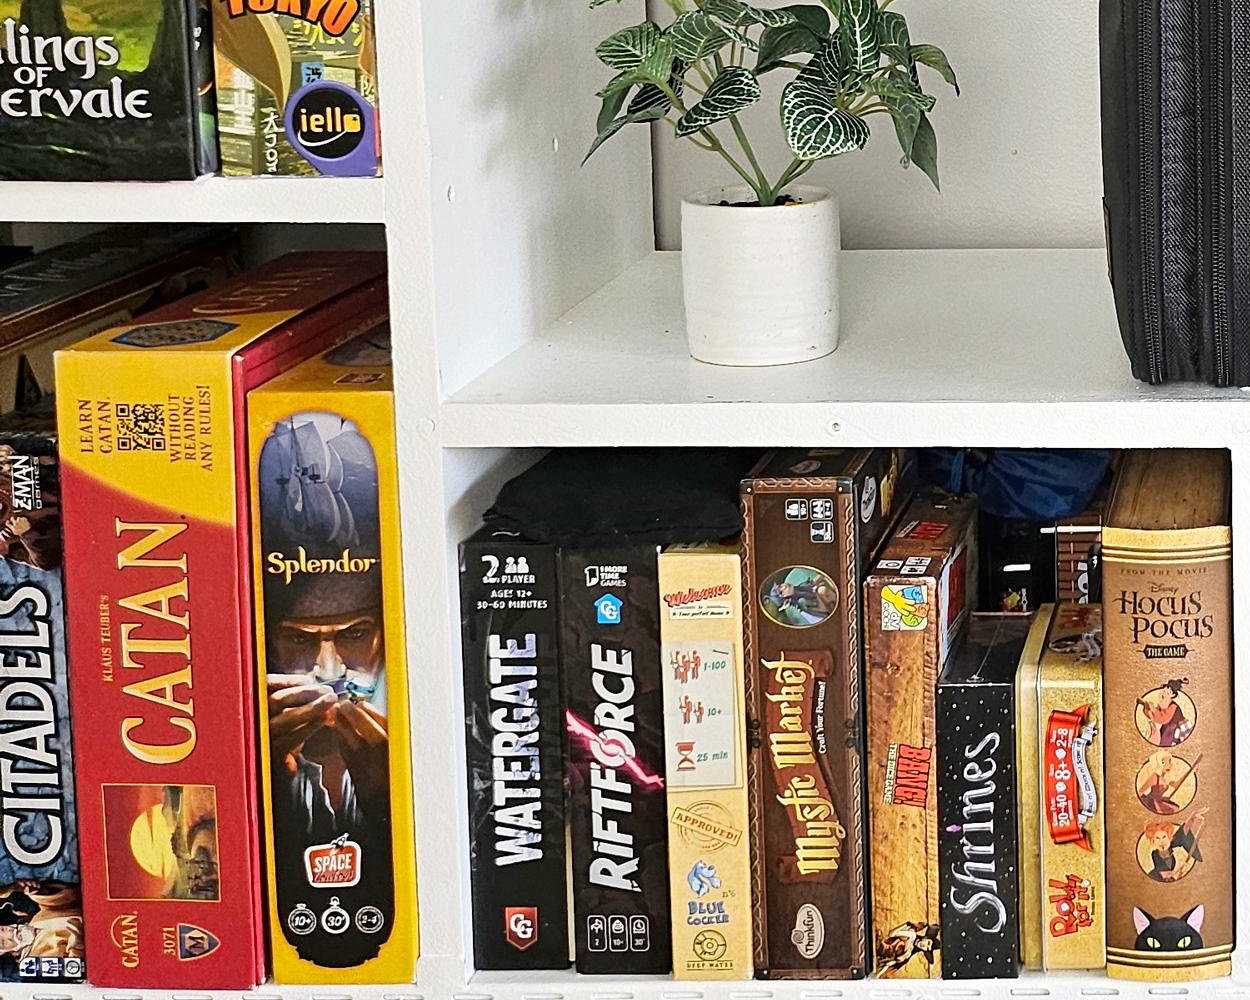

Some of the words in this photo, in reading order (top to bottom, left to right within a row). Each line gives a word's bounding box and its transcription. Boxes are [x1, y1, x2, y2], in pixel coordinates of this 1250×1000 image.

[0, 19, 118, 80] lings
[301, 107, 361, 133] iello
[196, 385, 212, 437] RULES!
[79, 399, 94, 453] LEARN
[169, 394, 182, 462] WITHOUT
[184, 396, 197, 460] READING
[201, 439, 213, 471] ANY
[267, 545, 376, 585] Splendor
[501, 575, 535, 584] PLAYER
[1177, 567, 1207, 575] MOVIE
[508, 600, 547, 609] MINUTES
[1112, 590, 1202, 617] HOCUS
[101, 595, 112, 643] TEUBER'S
[1129, 615, 1214, 644] POCUS
[116, 516, 197, 764] CATAN
[1147, 647, 1162, 656] THE
[1164, 647, 1185, 657] GAME
[102, 646, 113, 682] KLAUS
[761, 650, 816, 769] Market
[815, 681, 827, 712] Fortune!
[0, 583, 63, 865] CITADELS
[707, 707, 722, 716] 10+
[815, 714, 826, 732] Your
[490, 633, 543, 866] WATERGATE
[818, 733, 827, 754] Craft
[1055, 728, 1069, 747] 2-8
[697, 752, 710, 762] 25
[712, 751, 728, 760] min
[1055, 761, 1071, 780] 8+
[894, 744, 932, 808] BANG!
[776, 774, 846, 875] Mystic
[1056, 794, 1070, 827] 20-40
[676, 813, 738, 842] APPROVED!
[950, 731, 1007, 933] Shrines
[314, 853, 352, 873] SPACE
[294, 916, 312, 926] 10+
[361, 915, 377, 924] 2-4
[687, 914, 729, 925] COCKER
[688, 901, 725, 915] BLUE
[163, 927, 176, 955] 3071
